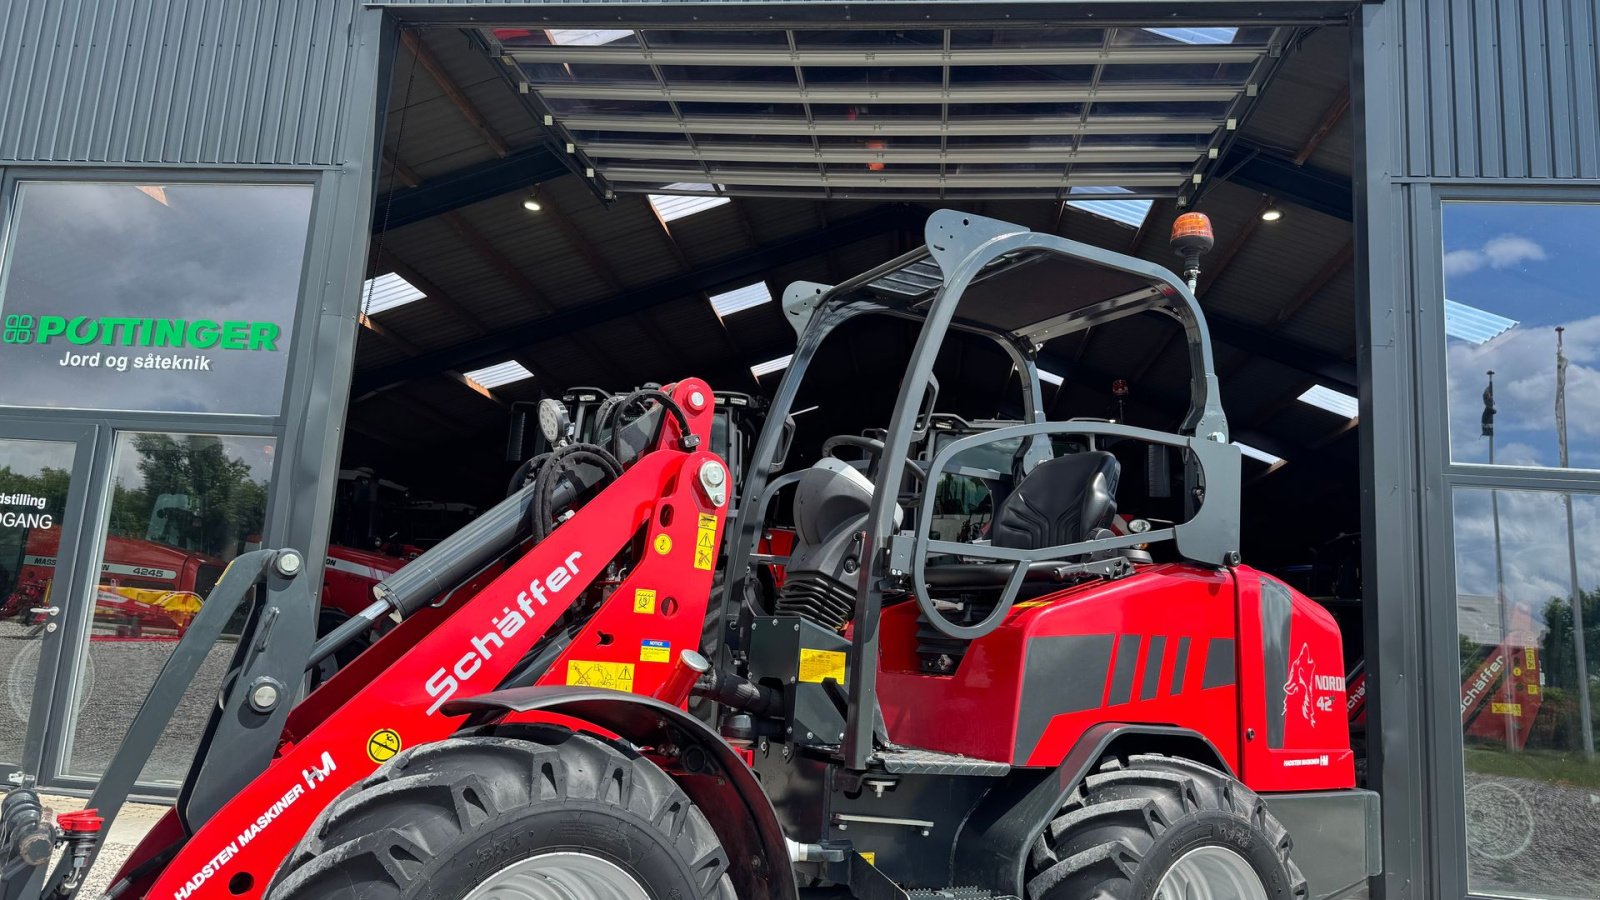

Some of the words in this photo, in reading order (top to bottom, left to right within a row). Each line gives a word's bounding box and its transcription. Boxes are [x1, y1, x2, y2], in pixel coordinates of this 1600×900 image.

[60, 351, 100, 367] Jord
[106, 355, 127, 371] og
[133, 352, 211, 371] såteknik
[0, 512, 52, 529] GANG
[133, 567, 164, 577] 4245
[425, 551, 582, 716] Schäffer
[173, 841, 239, 900] HADSTEN
[238, 784, 305, 847] MASKINER
